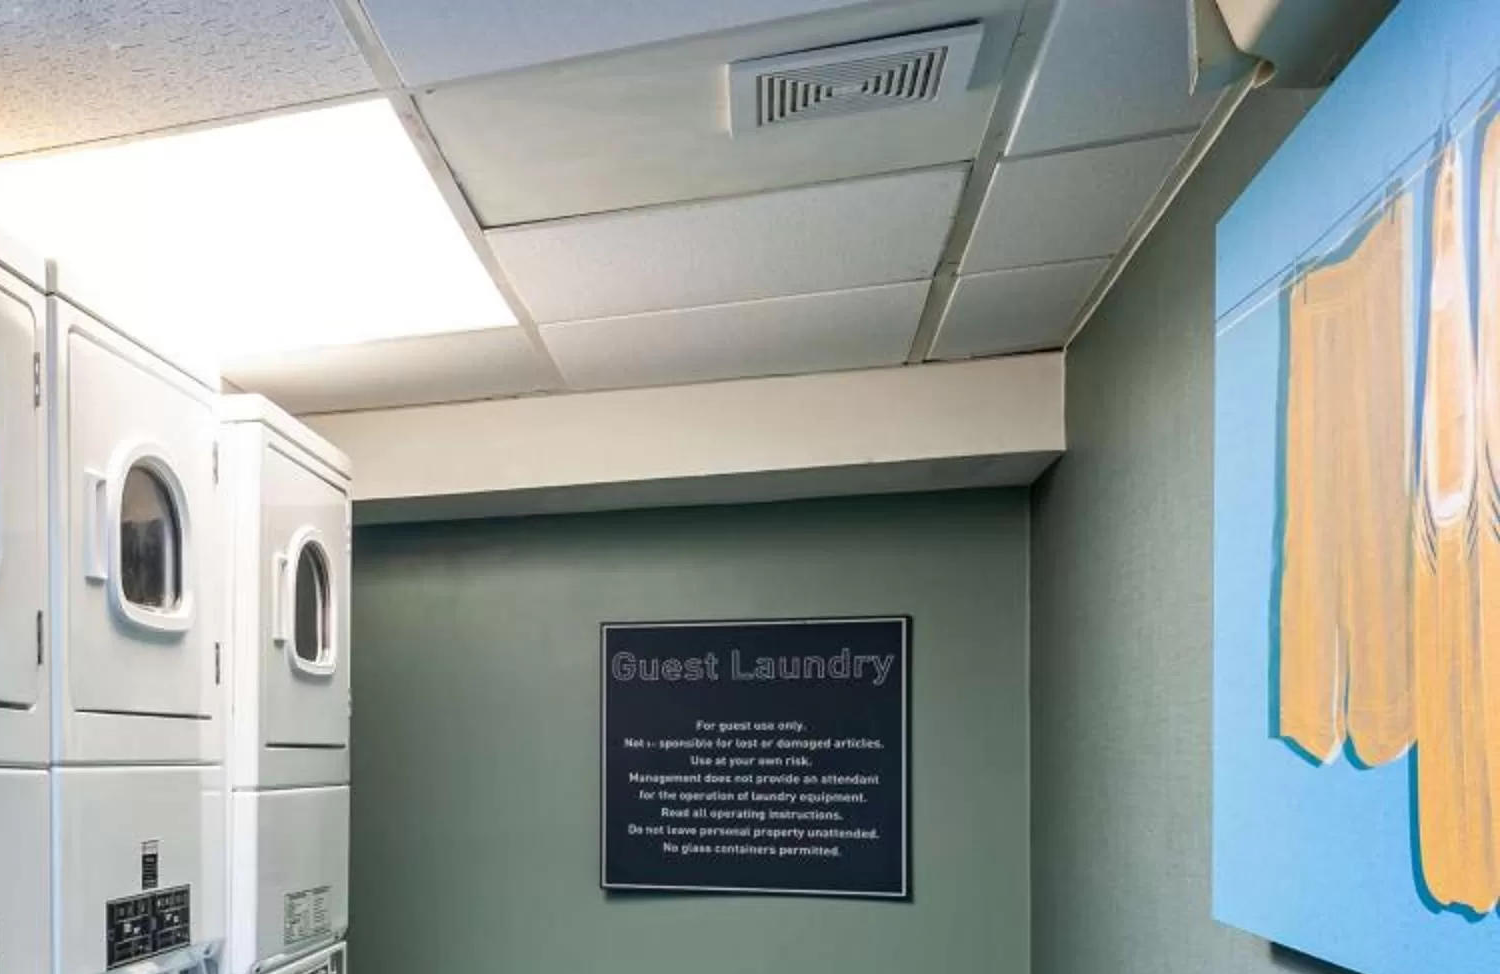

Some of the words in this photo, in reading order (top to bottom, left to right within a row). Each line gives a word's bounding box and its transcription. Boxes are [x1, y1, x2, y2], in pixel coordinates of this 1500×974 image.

[611, 651, 719, 681] Guest
[731, 648, 894, 686] Laundry
[696, 720, 716, 731] For
[719, 721, 751, 733] guest
[753, 722, 775, 731] use
[777, 721, 807, 733] only.
[624, 738, 644, 748] Not
[716, 738, 732, 748] for
[735, 738, 757, 748] lost
[761, 740, 772, 748] or
[776, 738, 831, 751] damaged
[834, 738, 884, 749] articles.
[690, 755, 713, 766] Use
[715, 757, 727, 766] at
[729, 757, 755, 768] your
[758, 757, 783, 766] own
[785, 756, 812, 767] risk.
[628, 772, 701, 785] Management
[703, 774, 732, 783] does
[734, 775, 753, 783] not
[755, 774, 800, 785] provide
[803, 776, 819, 784] an
[821, 774, 879, 785] attendant
[639, 790, 655, 800] for
[658, 790, 677, 800] the
[679, 791, 735, 802] operation
[737, 791, 749, 800] of
[751, 792, 797, 804] laundry
[799, 792, 868, 804] equipment.
[661, 807, 690, 818] Read
[692, 808, 707, 818] all
[709, 809, 765, 821] operating
[768, 809, 843, 820] instructions.
[627, 823, 643, 835] Do
[645, 825, 664, 835] not
[666, 825, 697, 835] leave
[699, 826, 751, 838] personal
[753, 828, 804, 840] property
[807, 828, 880, 839] unattended.
[663, 841, 679, 852] No
[681, 843, 712, 855] glass
[715, 844, 776, 855] containers
[779, 846, 842, 857] permitted.
